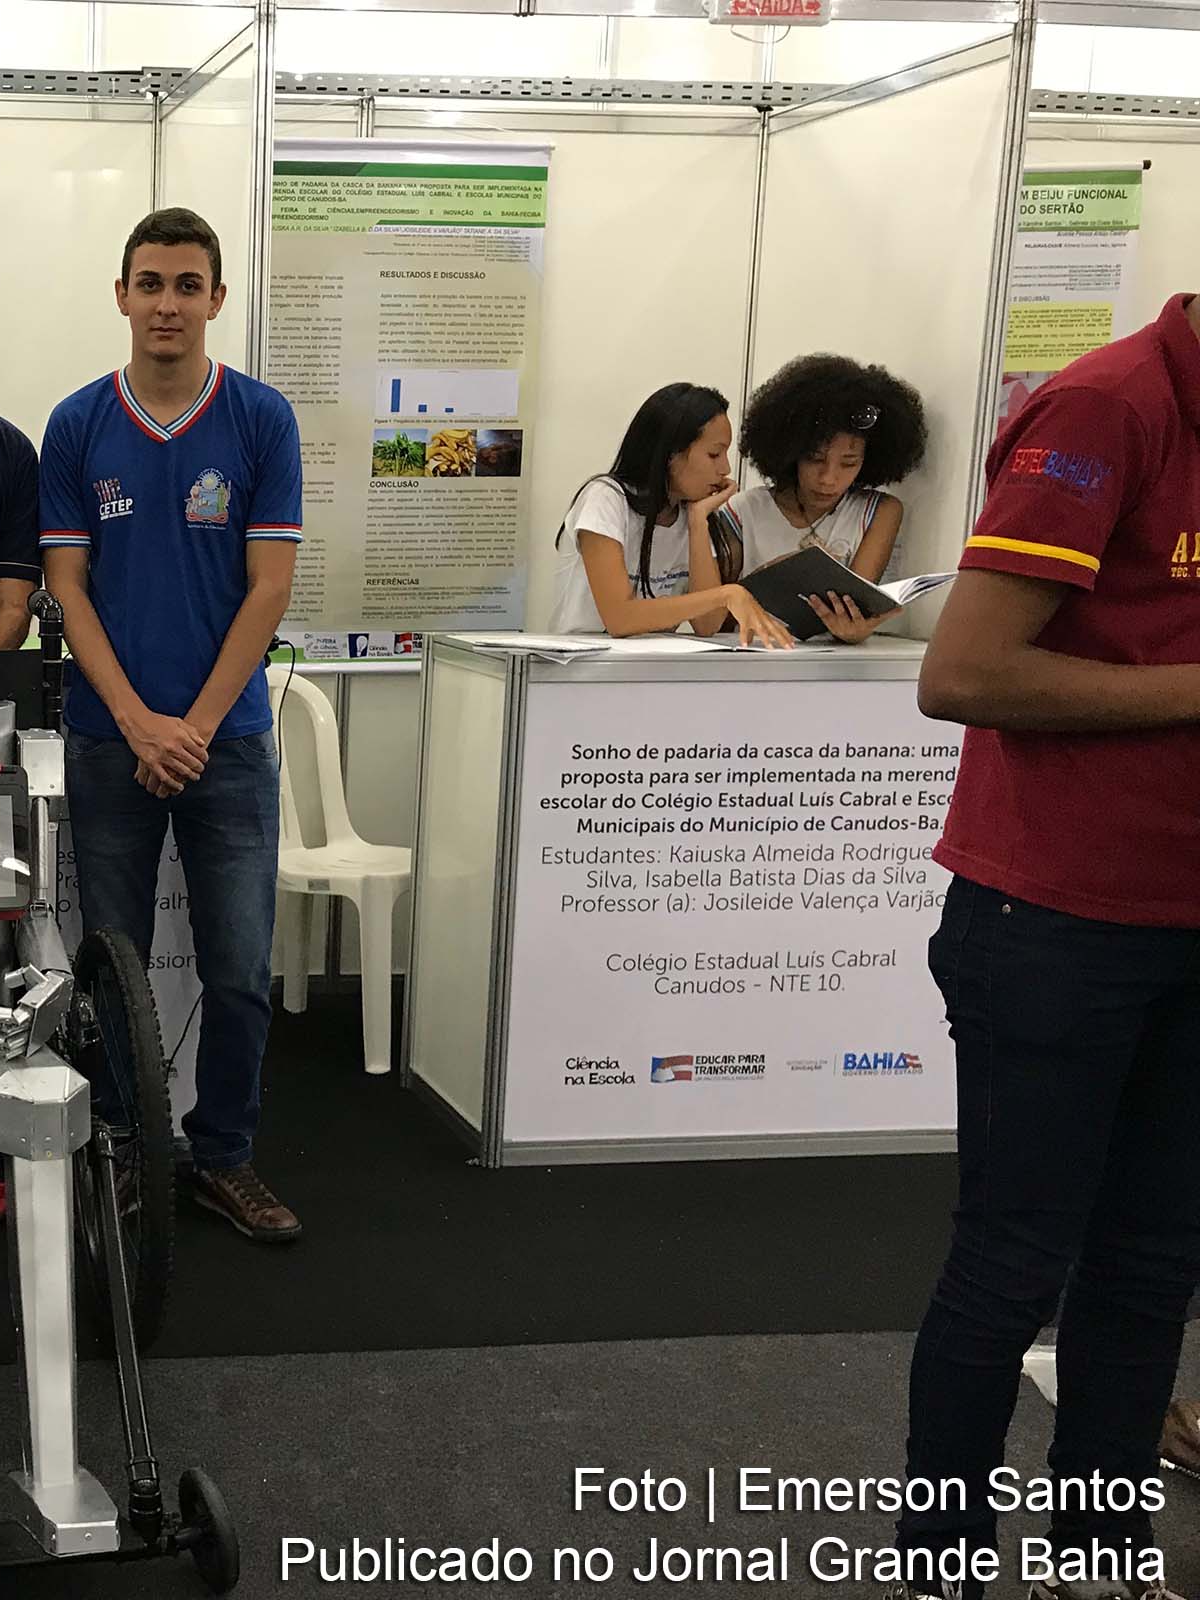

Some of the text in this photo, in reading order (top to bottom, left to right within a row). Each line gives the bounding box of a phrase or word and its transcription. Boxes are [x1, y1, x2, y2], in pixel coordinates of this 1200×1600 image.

[1020, 189, 1128, 200] M BEIJU FUNCIONAL
[1020, 202, 1084, 215] DO SERTÃO
[379, 269, 486, 280] RESULTADOS E DISCUSSÃO
[369, 480, 419, 488] CONCLUSÃO
[100, 498, 133, 516] CETEP
[366, 577, 420, 586] REFERÊNCIAS
[571, 743, 959, 763] Sonho de padaria da casca da banana: uma
[560, 766, 956, 788] proposta para ser implementada na merend
[540, 790, 953, 812] escolar do Colégio Estadual Luís Cabral e Esco
[576, 815, 944, 837] Municipais do Município de Canudos-Ba.
[541, 843, 933, 865] Estudantes: Kaiuska Almeida Rodrigue
[586, 866, 927, 890] Silva, Isabella Batista Dias da Silva
[561, 894, 660, 913] Professor
[666, 893, 696, 914] (a):
[703, 892, 793, 911] Josileide
[800, 892, 879, 914] Valença
[606, 949, 897, 975] Colégio Estadual Luís Cabral
[654, 976, 745, 995] Canudos
[770, 974, 811, 993] NTE
[818, 973, 845, 992] 10.
[565, 1056, 620, 1070] Ciência
[695, 1054, 766, 1065] EDUCAR PARA
[843, 1053, 909, 1070] BAHIA
[694, 1064, 766, 1075] TRANSFORMAR
[564, 1072, 636, 1086] na Escola
